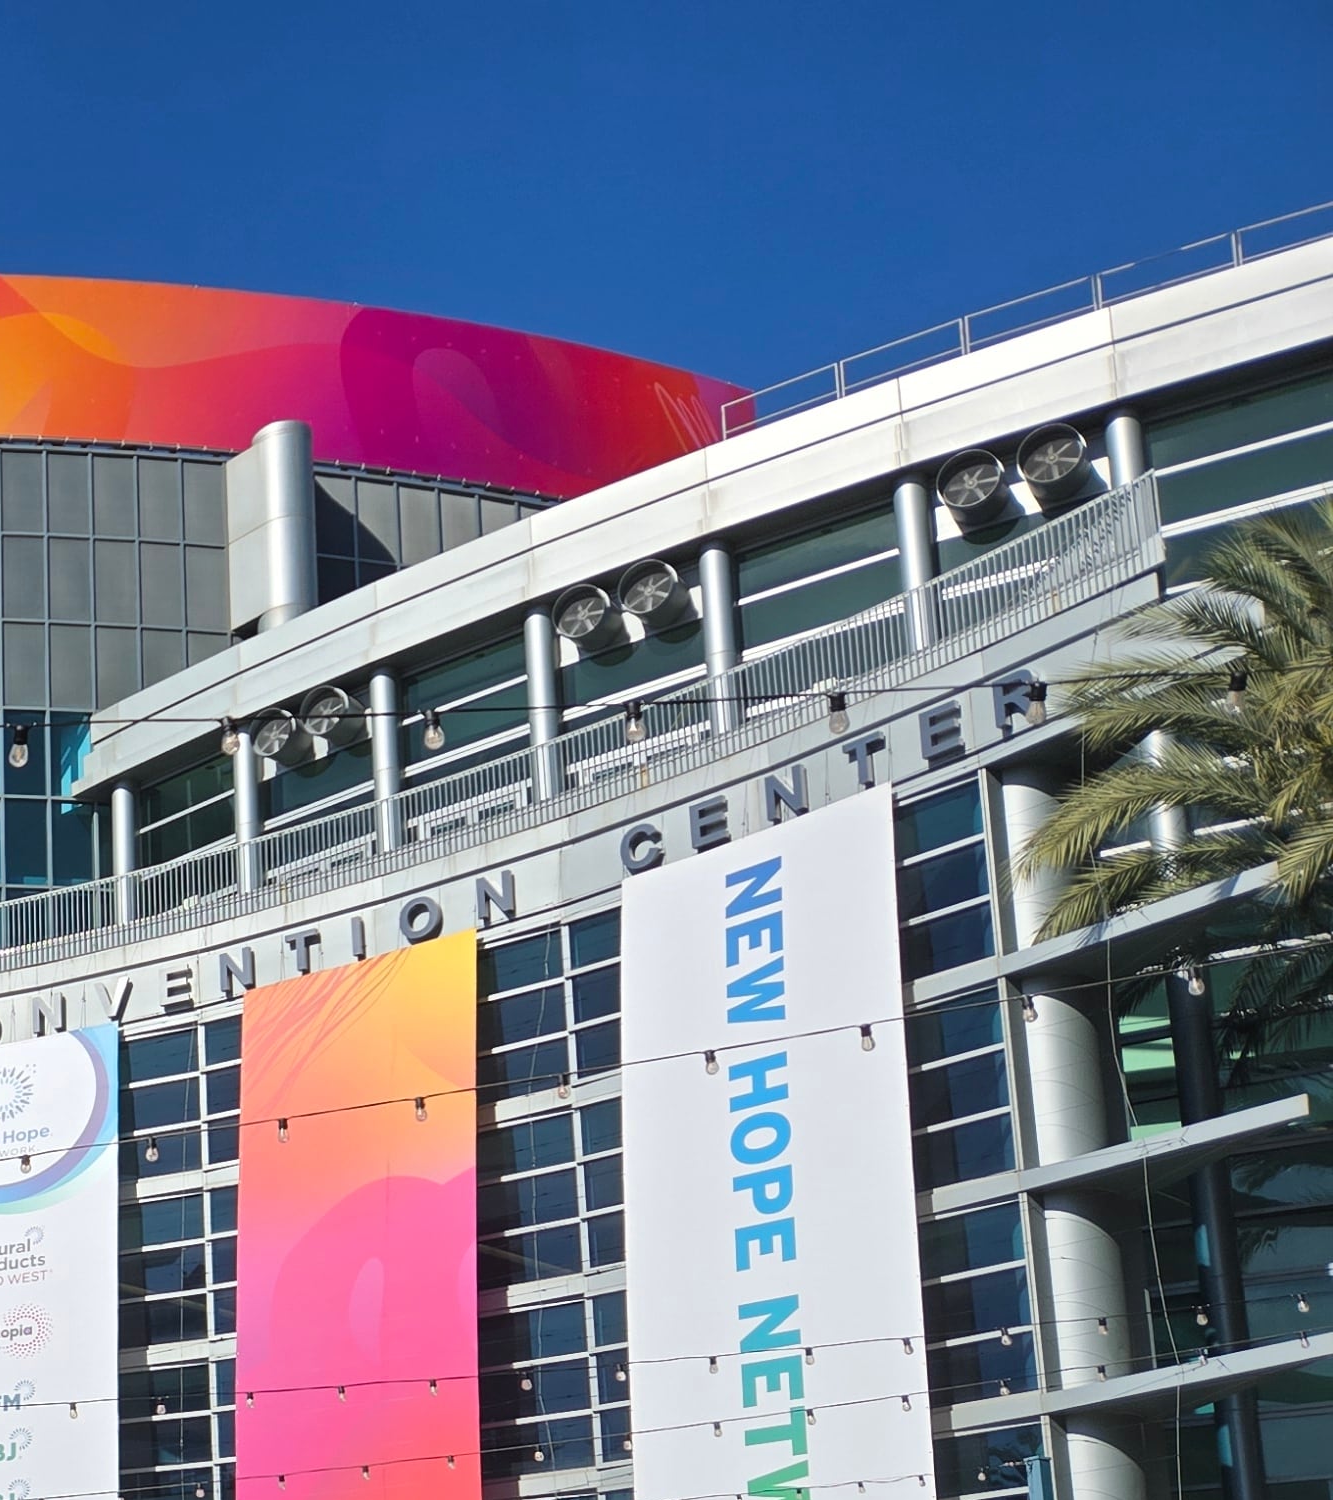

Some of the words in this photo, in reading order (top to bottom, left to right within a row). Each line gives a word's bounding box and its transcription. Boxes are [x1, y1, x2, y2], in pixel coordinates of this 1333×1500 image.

[620, 668, 1047, 874] CENTER
[725, 855, 786, 1025] NEW
[2, 1126, 51, 1144] Hope
[728, 1051, 798, 1273] HOPE
[7, 1269, 48, 1285] WEST
